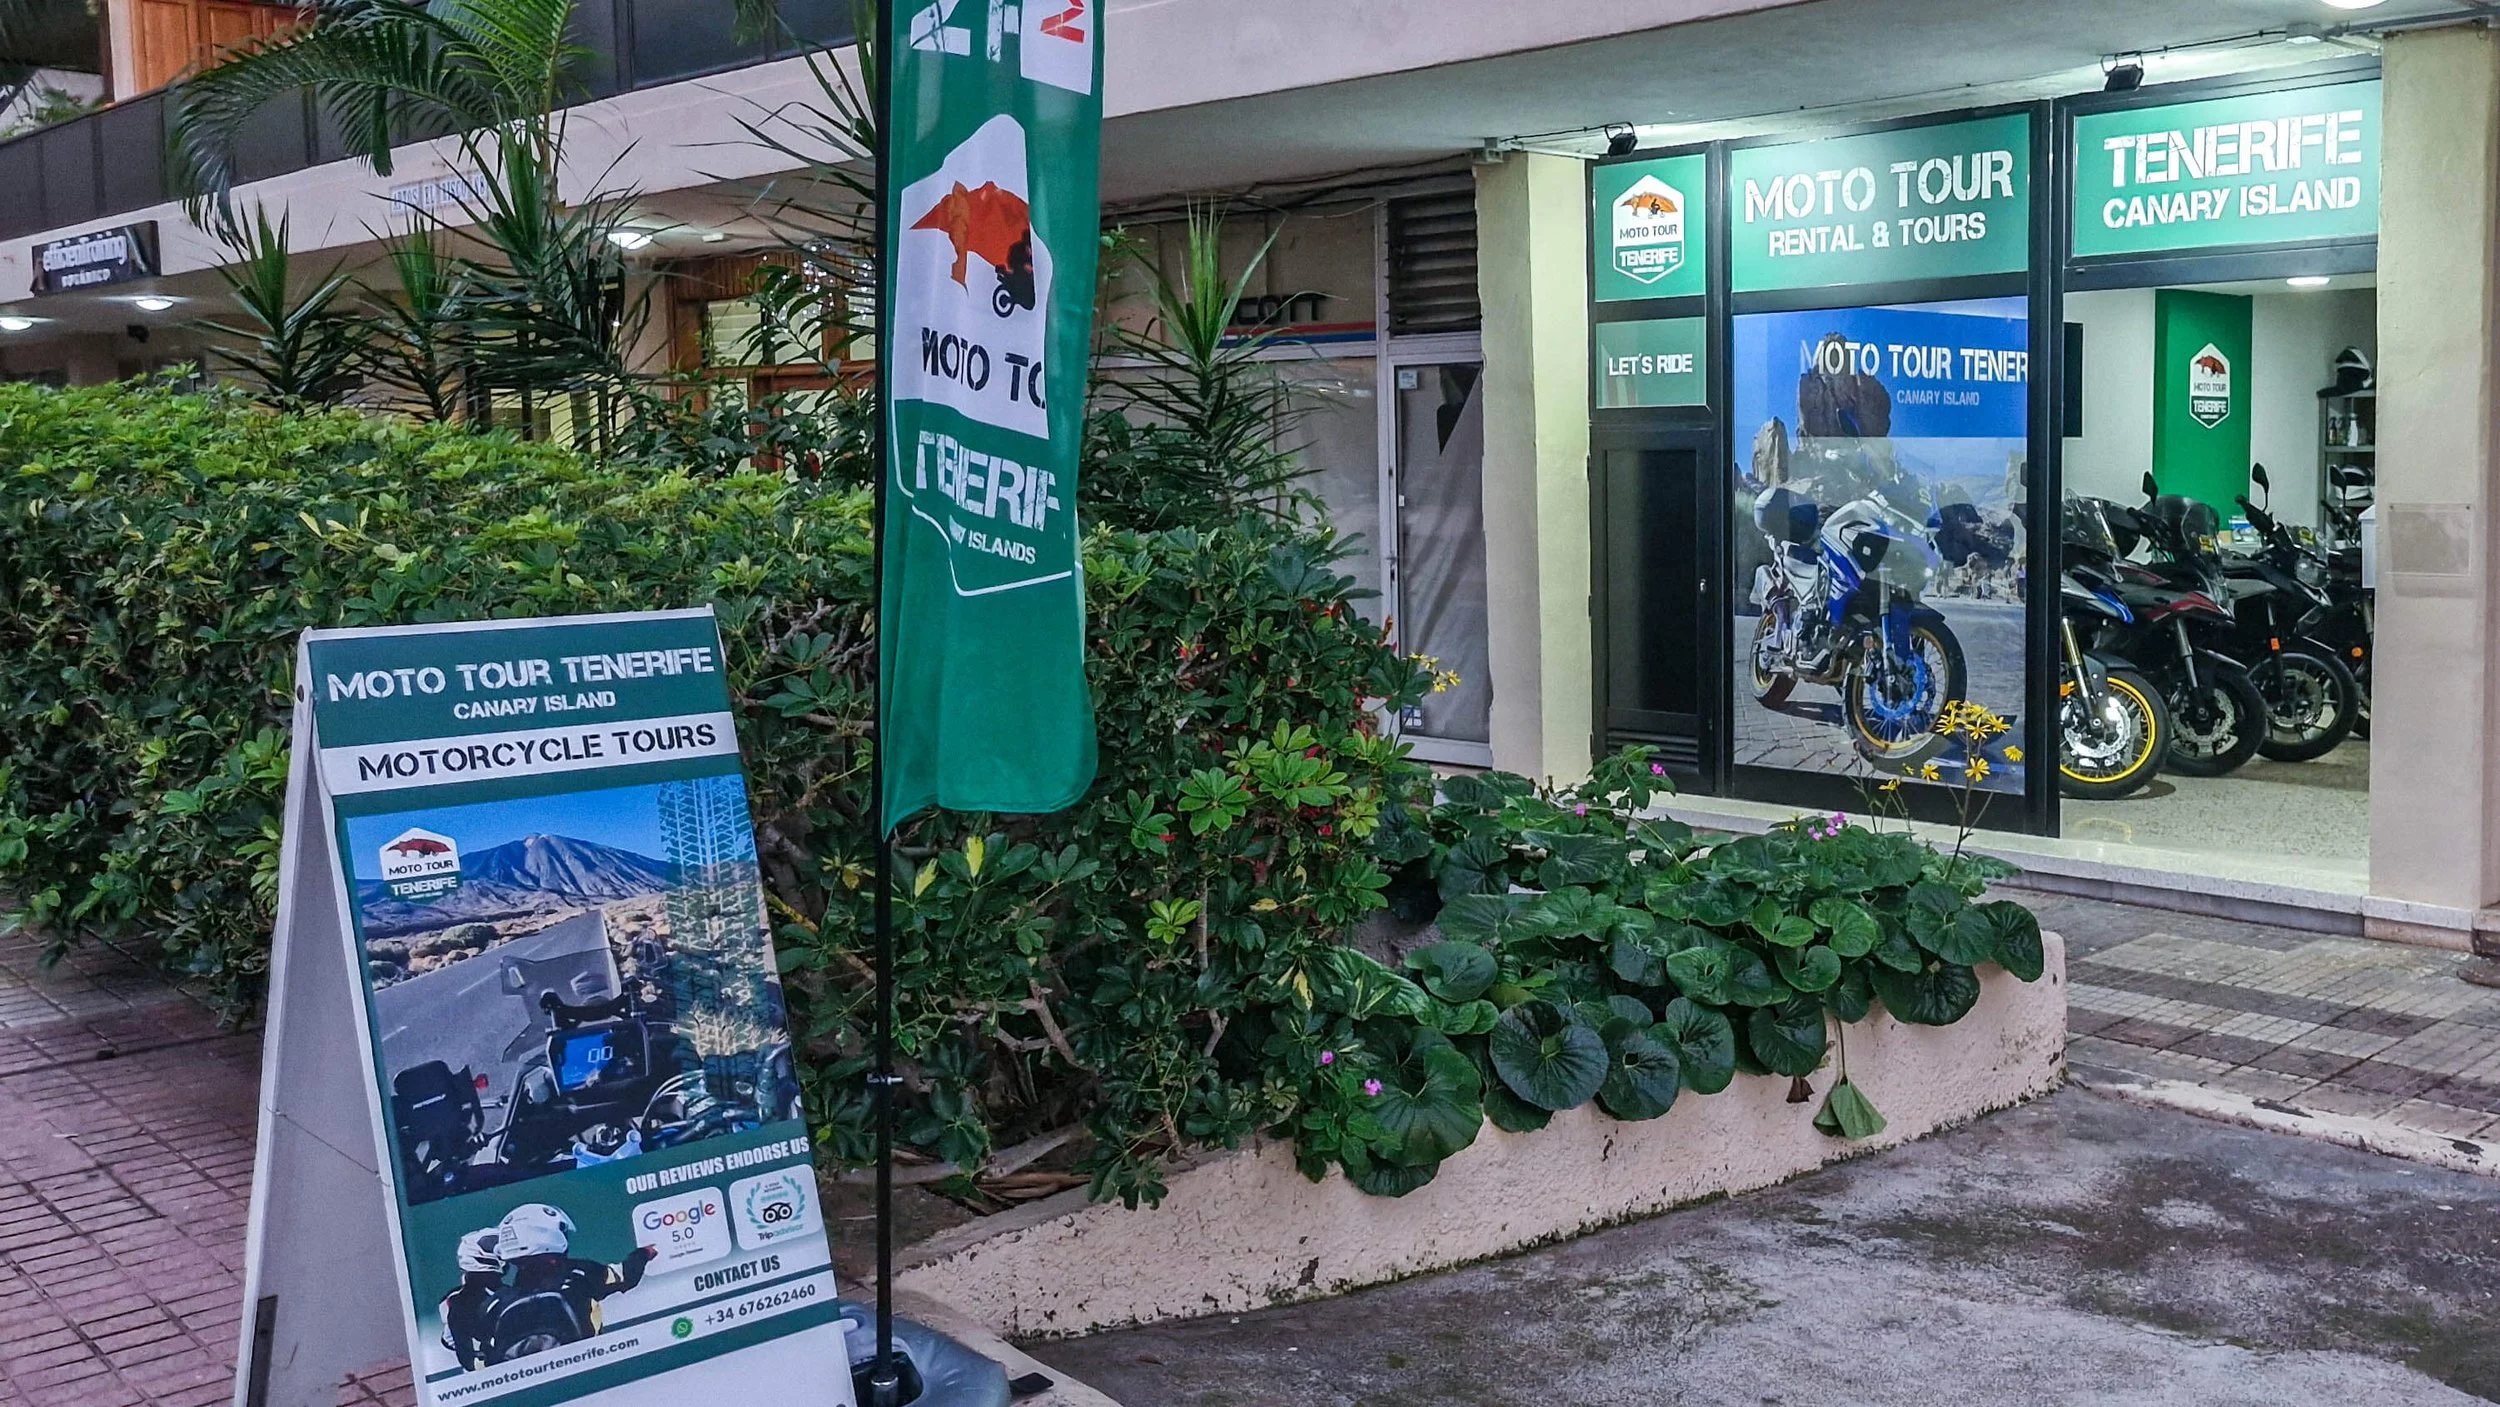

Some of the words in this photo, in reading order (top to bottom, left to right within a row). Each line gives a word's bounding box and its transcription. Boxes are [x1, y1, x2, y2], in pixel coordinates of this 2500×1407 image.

[2104, 110, 2363, 187] TENERIFE
[1745, 167, 1876, 222] MOTO
[1891, 150, 2014, 208] TOUR
[2103, 188, 2231, 229] CANARY
[2240, 176, 2361, 217] ISLAND
[1619, 227, 1649, 239] MOTO
[1653, 224, 1677, 236] TOUR
[1769, 224, 1864, 257] RENTAL
[1872, 220, 1890, 248] &
[1898, 211, 1986, 246] TOURS
[1619, 247, 1678, 266] TENERIFE
[1657, 354, 1692, 373] RIDE
[1801, 340, 1880, 377] MOTO
[1888, 344, 1952, 379] TOUR
[1960, 348, 2027, 382] TENER
[1897, 390, 1939, 405] CANARY
[1943, 391, 1979, 406] ISLAND
[2213, 383, 2226, 392] TOUR
[968, 530, 1036, 564] ISLANDS
[328, 666, 446, 702] MOTO
[456, 659, 553, 692] TOUR
[560, 647, 714, 683] TENERIFE
[453, 697, 537, 720] CANARY
[545, 691, 616, 712] ISLAND
[358, 733, 602, 781] MOTORCYCLE
[612, 723, 716, 755] TOURS
[389, 864, 422, 875] MOTO
[425, 860, 453, 871] TOUR
[391, 876, 457, 896] TENERIFE
[626, 1176, 658, 1195] OUR
[659, 1157, 724, 1187] REVIEWS
[726, 1143, 789, 1170] ENDORSE
[791, 1136, 810, 1154] US
[643, 1200, 716, 1231] Google
[672, 1227, 694, 1243] 5.0
[694, 1260, 758, 1292] CONTACT
[761, 1254, 781, 1273] US
[705, 1307, 735, 1326] +34
[739, 1284, 816, 1316] 676262460
[437, 1336, 640, 1402] www.mototourtenerife.com
